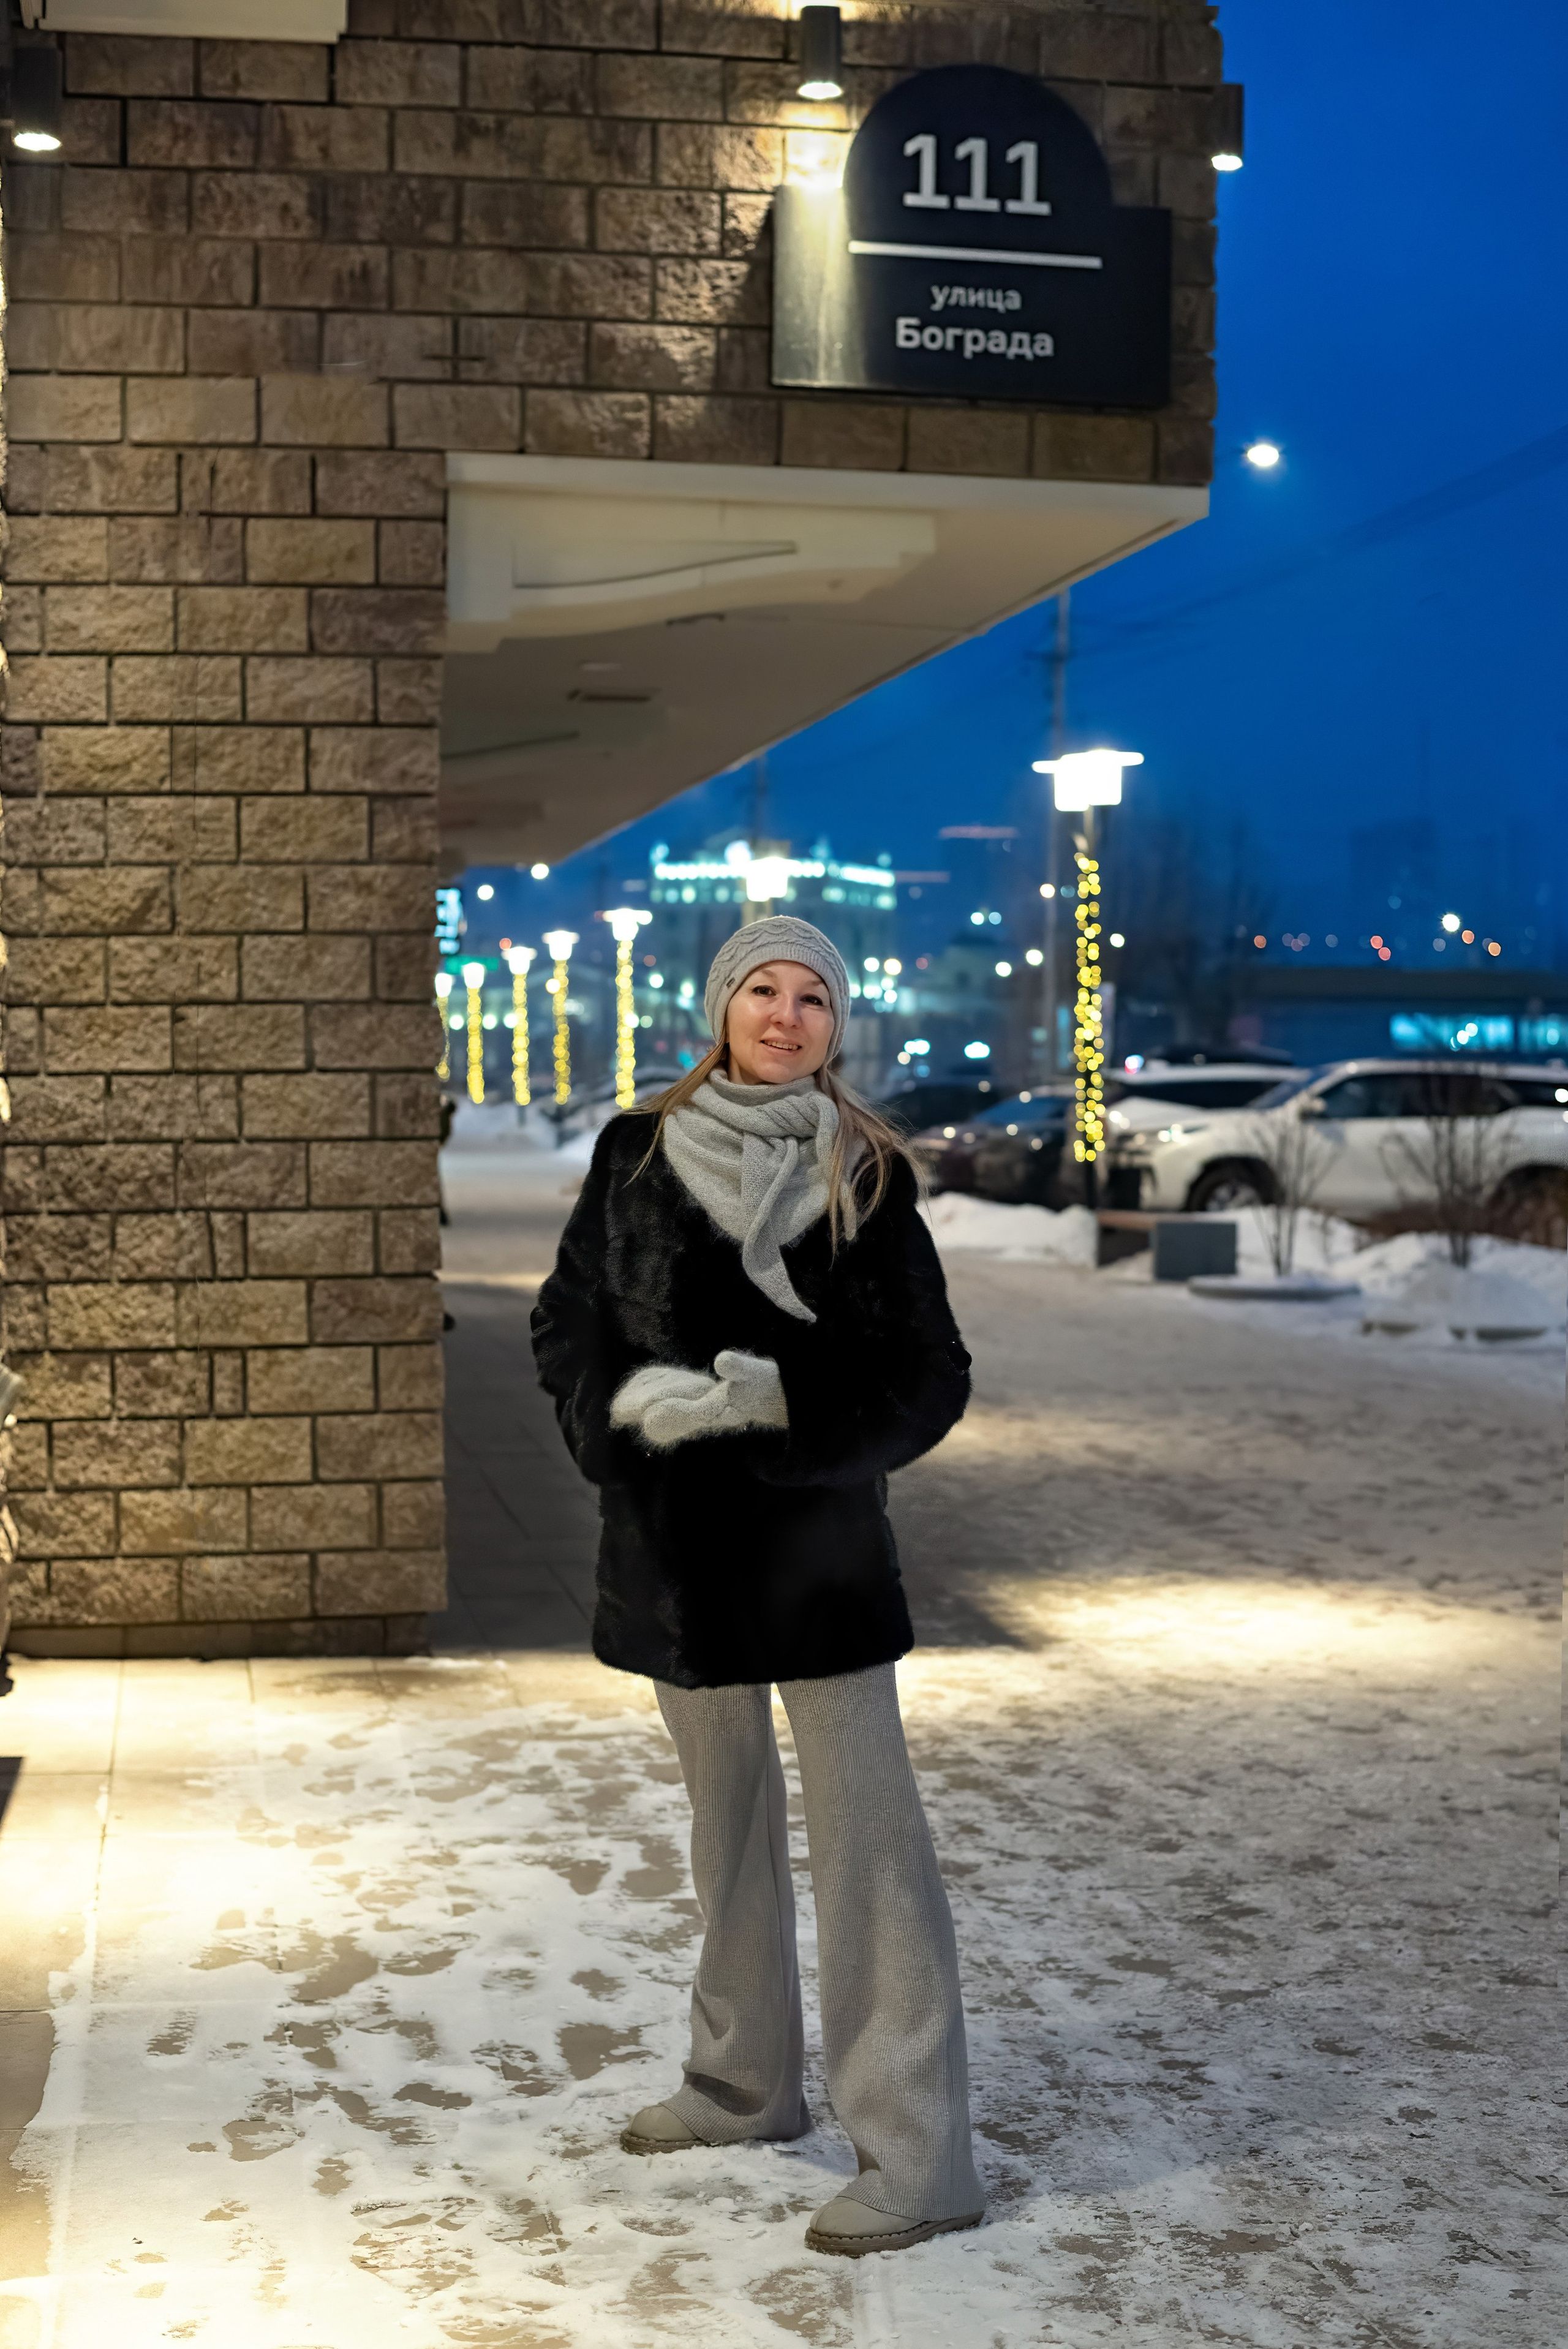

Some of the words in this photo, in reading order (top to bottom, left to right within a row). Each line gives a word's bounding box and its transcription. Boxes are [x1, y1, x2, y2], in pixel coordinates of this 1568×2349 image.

[902, 132, 1052, 216] 111
[930, 285, 1022, 314] улица
[895, 316, 1054, 361] Бограда
